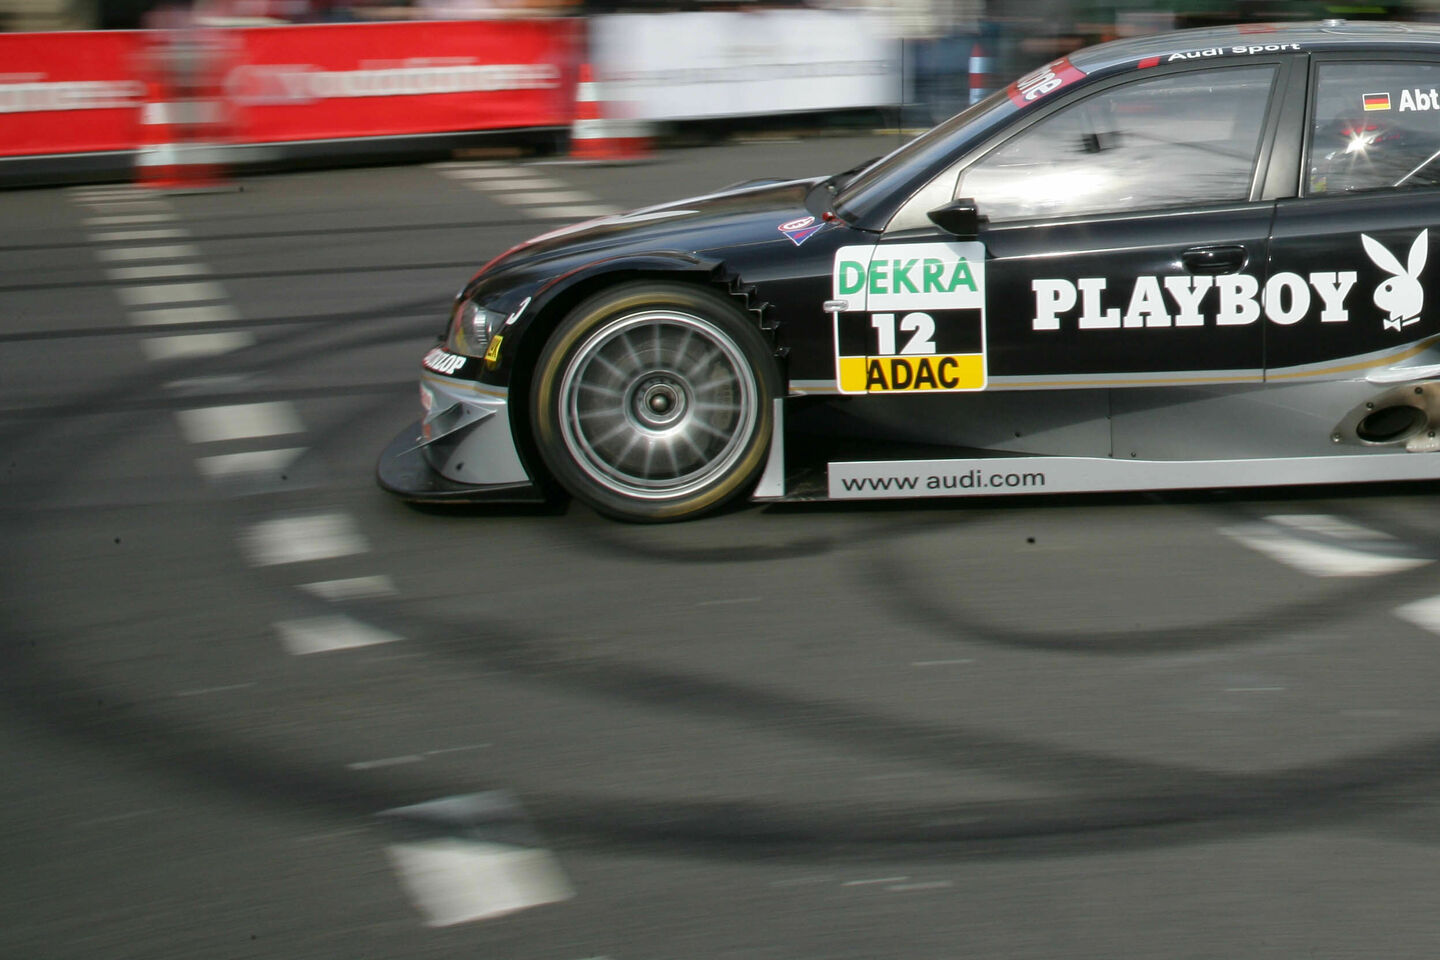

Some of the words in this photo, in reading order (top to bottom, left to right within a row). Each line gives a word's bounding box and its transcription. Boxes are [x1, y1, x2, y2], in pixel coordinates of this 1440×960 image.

[1168, 47, 1223, 62] Audi
[1232, 43, 1301, 55] Sport
[1399, 89, 1440, 111] Abt
[839, 257, 977, 294] DEKRA
[1032, 271, 1357, 330] PLAYBOY
[871, 312, 936, 355] 12
[866, 357, 960, 390] ADAC
